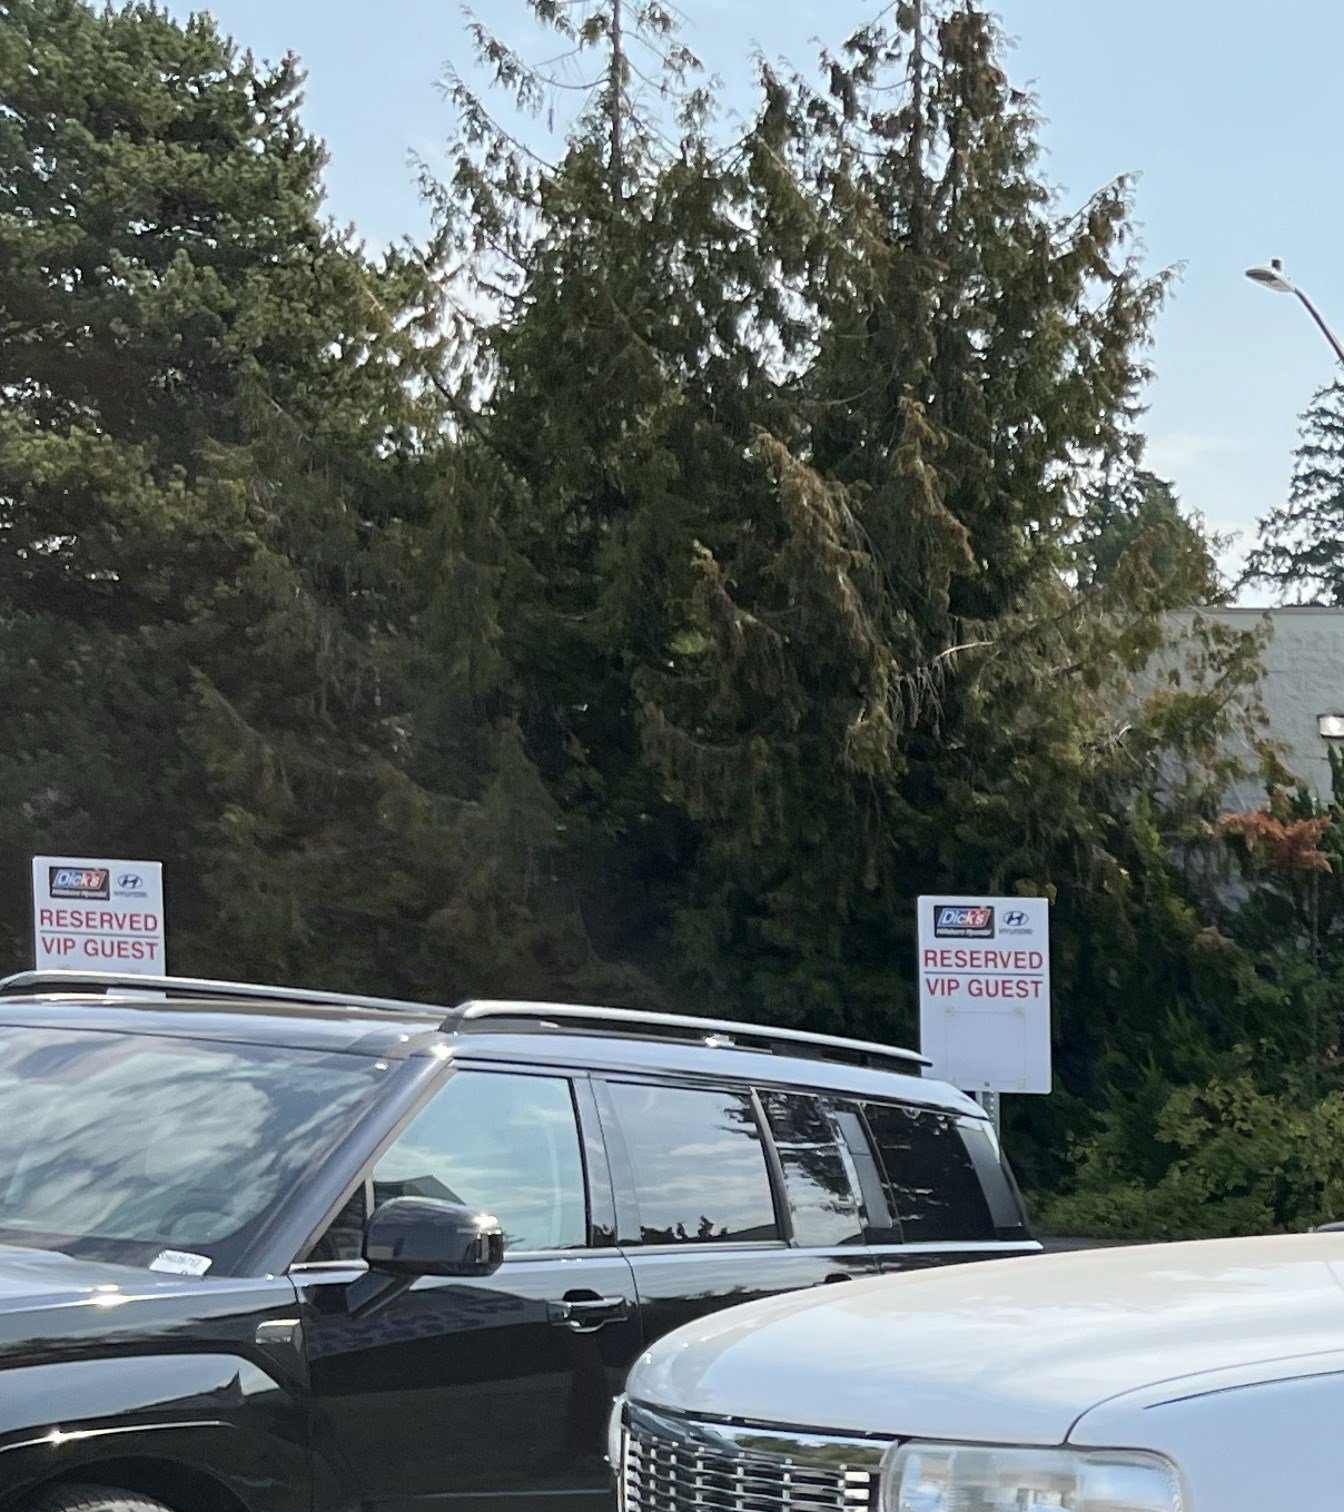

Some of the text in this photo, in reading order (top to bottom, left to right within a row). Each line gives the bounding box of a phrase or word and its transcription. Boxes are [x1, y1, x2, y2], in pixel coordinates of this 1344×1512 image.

[40, 909, 158, 931] RESERVED
[42, 937, 158, 960] VIP GUEST
[924, 950, 1043, 969] RESERVED
[926, 978, 1043, 998] VIP GUEST
